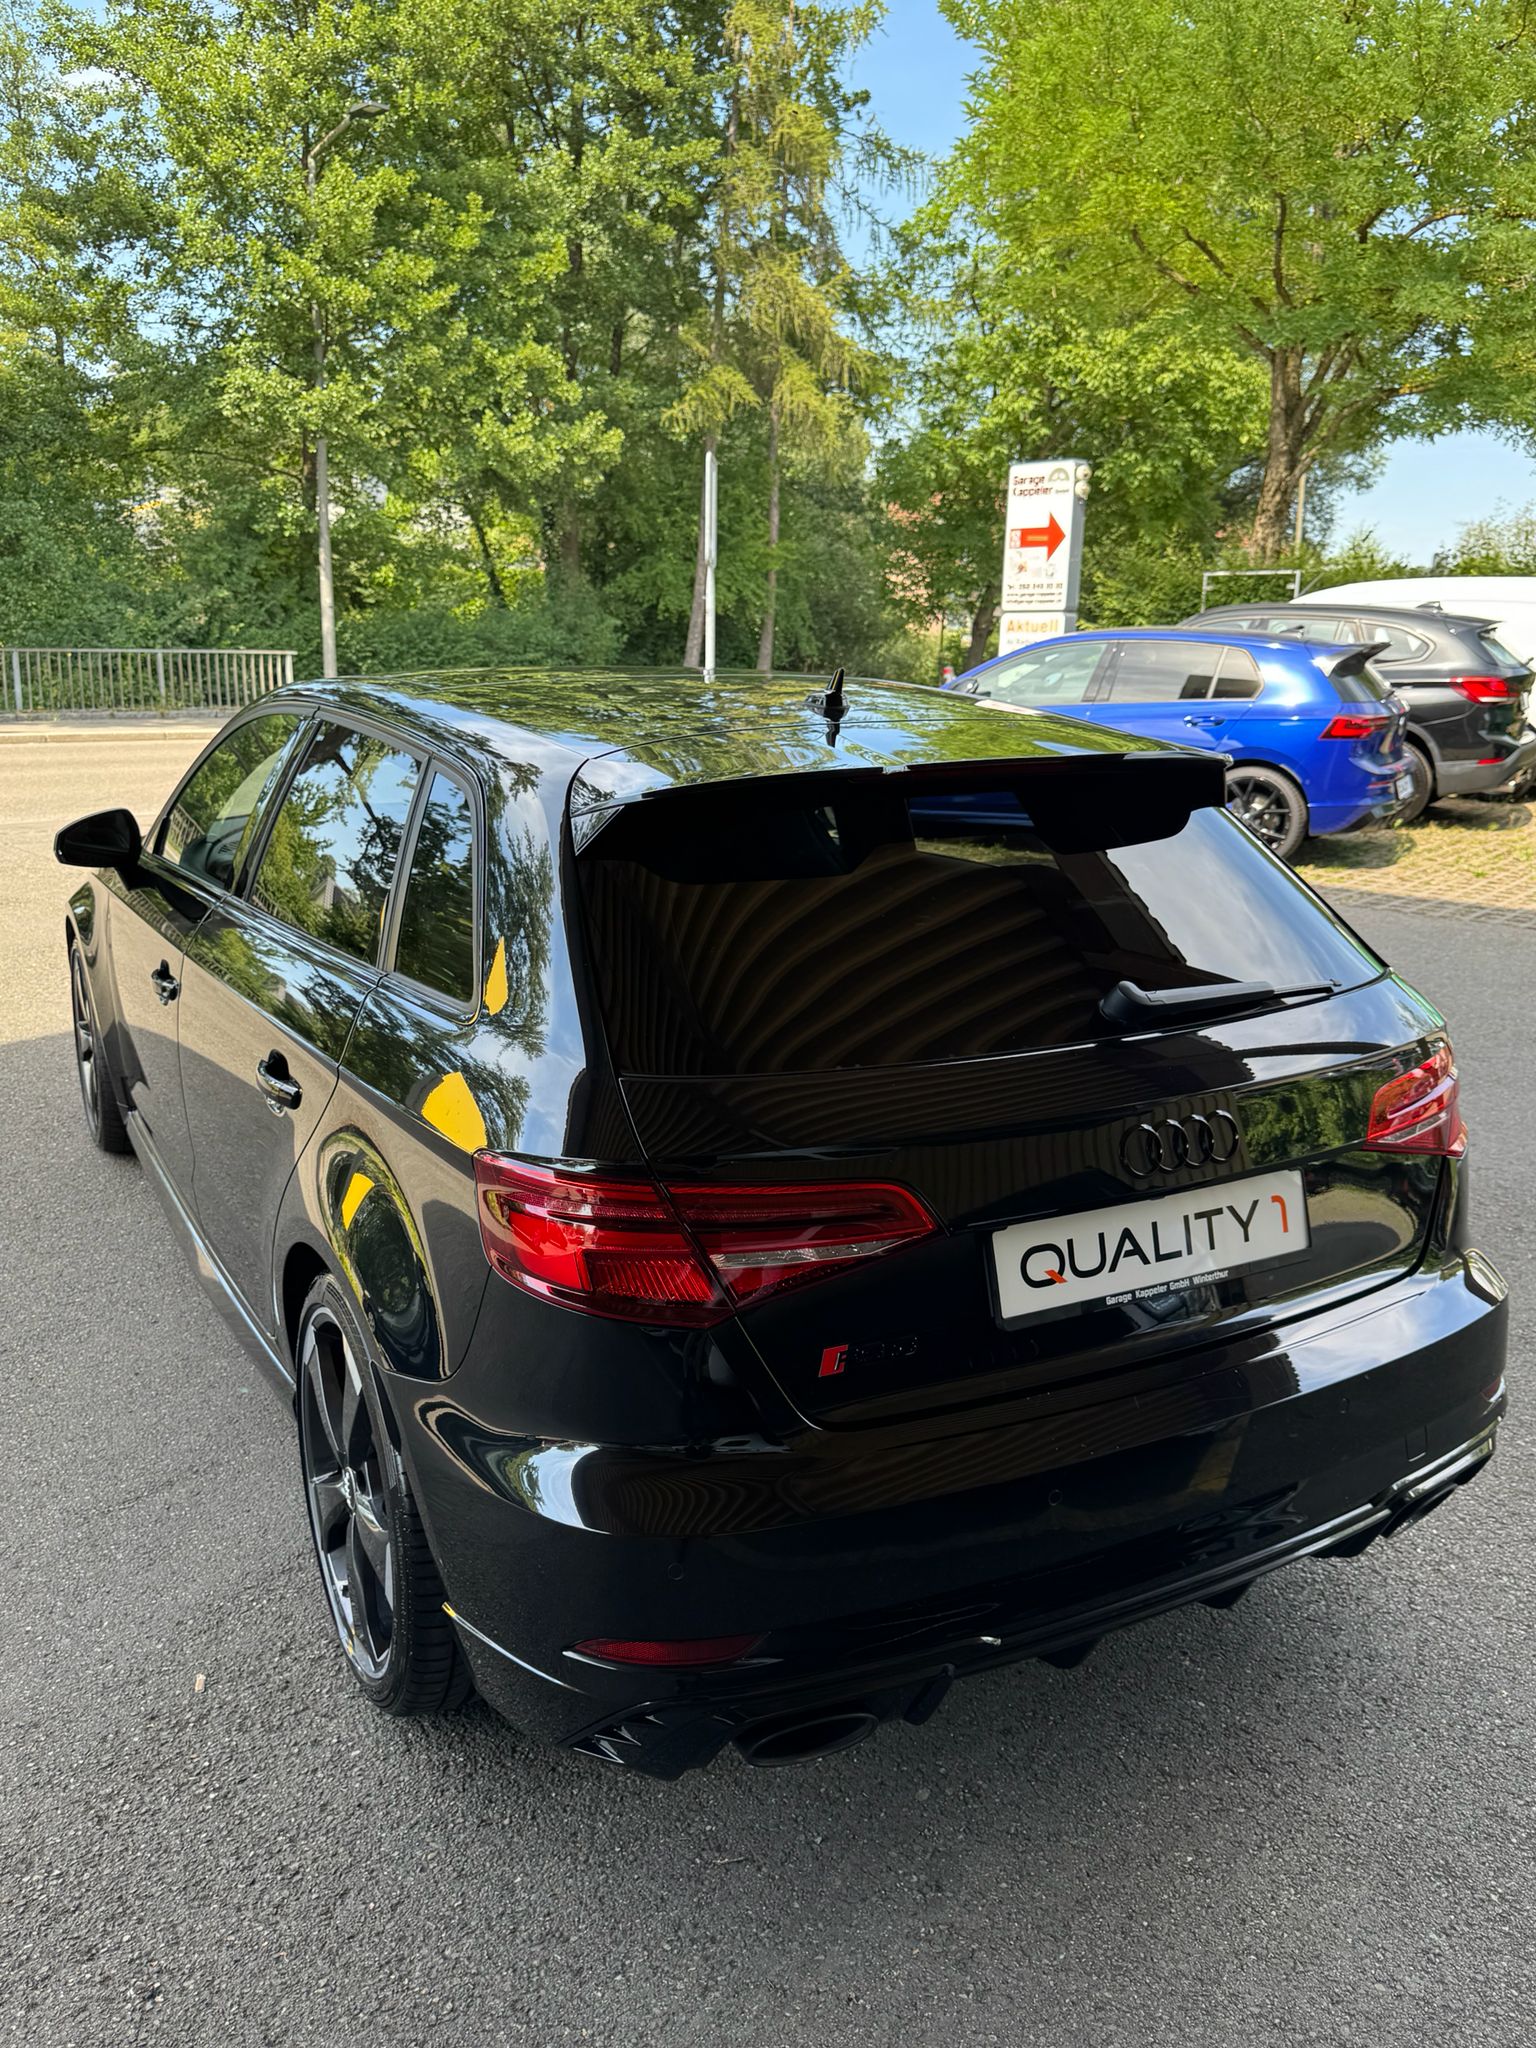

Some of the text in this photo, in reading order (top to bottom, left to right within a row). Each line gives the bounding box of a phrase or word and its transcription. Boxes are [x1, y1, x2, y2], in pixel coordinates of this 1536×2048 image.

[1007, 618, 1058, 633] Aktuell
[1020, 1198, 1260, 1289] QUALITY
[1105, 1269, 1229, 1306] Garage Kappeler GmbH Winterthur
